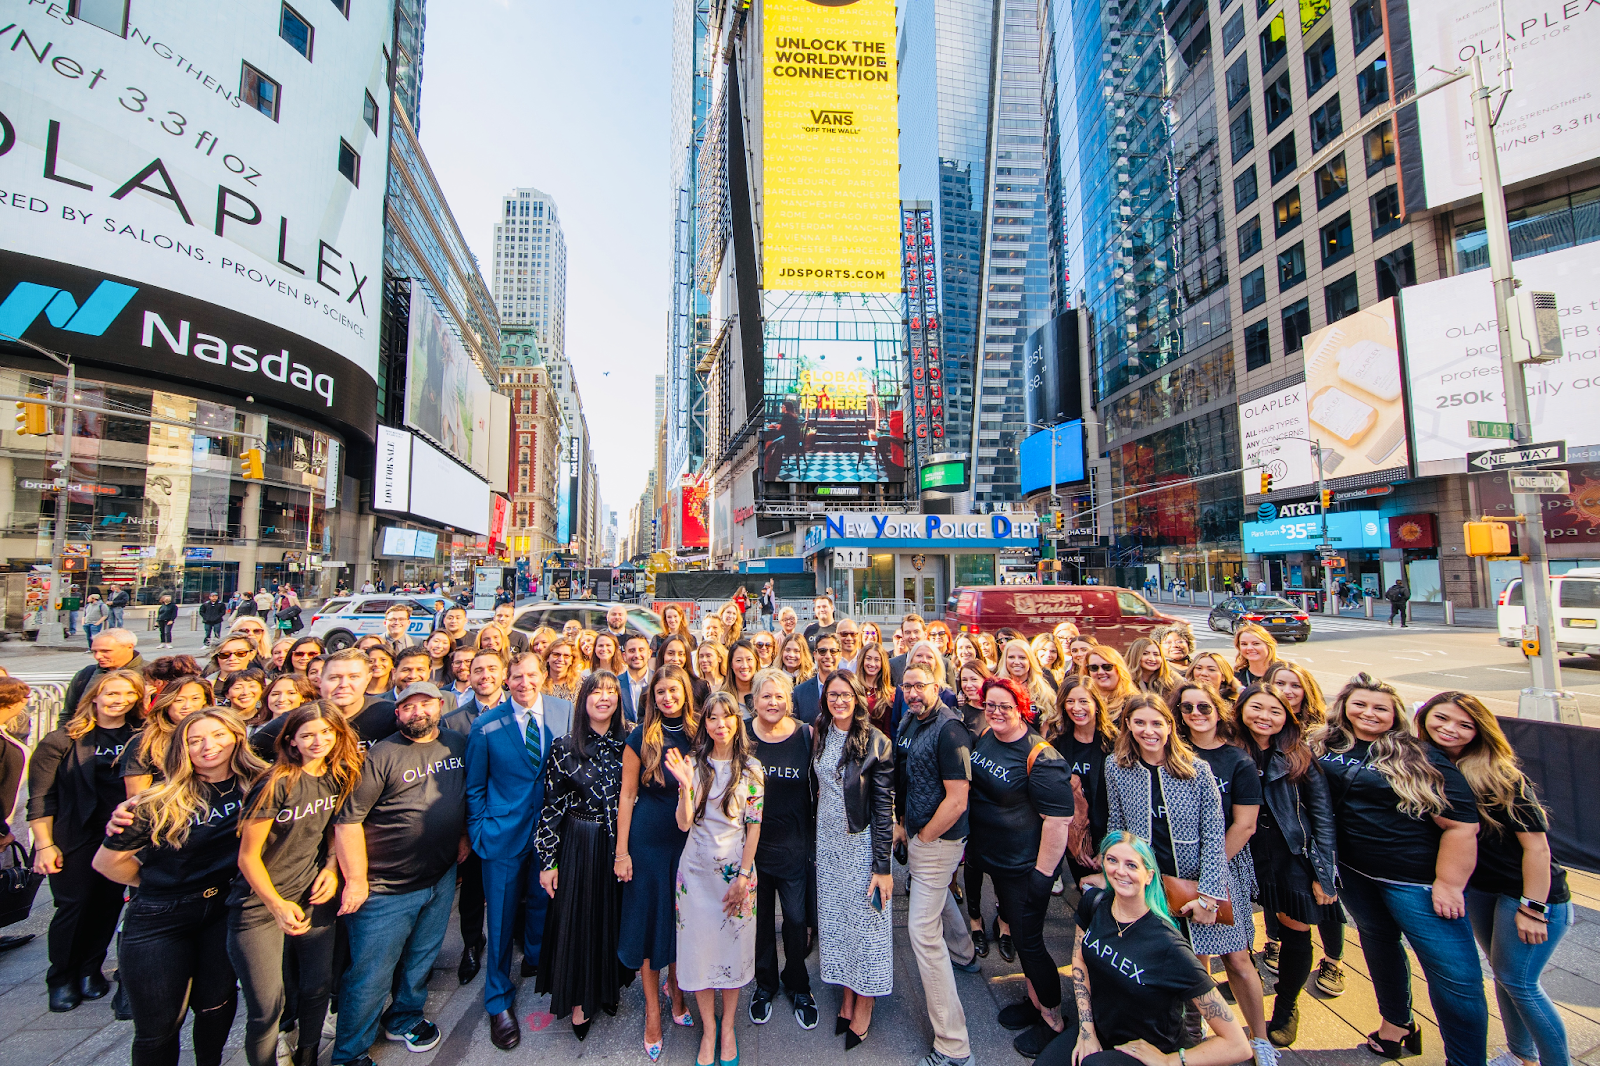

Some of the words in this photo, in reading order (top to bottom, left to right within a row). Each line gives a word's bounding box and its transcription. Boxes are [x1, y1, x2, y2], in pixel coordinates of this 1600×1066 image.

[766, 4, 829, 14] MANCHESTER
[839, 7, 896, 17] BARCELONA
[823, 17, 849, 25] ROME
[860, 19, 887, 28] PARIS
[778, 25, 804, 33] ROME
[815, 28, 872, 36] STOCKHOLM
[775, 37, 847, 52] UNLOCK
[852, 41, 886, 54] THE
[127, 20, 243, 109] NGTHENS
[775, 51, 887, 67] WORLDWIDE
[773, 65, 888, 82] CONNECTION
[803, 80, 861, 89] AMSTERDAM
[808, 90, 865, 99] BARCELONA
[779, 100, 819, 109] LONDON
[829, 102, 851, 110] NEW
[854, 104, 880, 112] YORK
[810, 109, 854, 126] VANS
[118, 86, 187, 136] 3.3
[222, 153, 262, 188] oz
[780, 133, 819, 141] LUMPUR
[829, 135, 865, 143] VIENNA
[781, 144, 819, 152] MUNICH
[829, 145, 872, 154] HELSINKI
[788, 155, 813, 163] YORK
[825, 156, 858, 165] BERLIN
[807, 167, 850, 176] CHICAGO
[861, 168, 891, 177] SEOUL
[778, 177, 837, 187] MELBOURNE
[847, 179, 875, 188] PARIS
[765, 187, 824, 197] BARCELONA
[781, 199, 845, 208] MANCHESTER
[856, 202, 877, 210] NEW
[780, 210, 807, 219] ROME
[818, 212, 862, 220] CHICAGO
[774, 222, 834, 230] AMSTERDAM
[784, 233, 821, 241] VIENNA
[831, 235, 878, 243] BANGKOK
[766, 245, 831, 253] MANCHESTER
[780, 256, 815, 264] BERLIN
[826, 257, 853, 266] ROME
[863, 258, 891, 267] PARIS
[905, 217, 918, 299] ERNST
[62, 205, 94, 225] BY
[103, 217, 212, 265] SALONS.
[221, 257, 298, 299] PROVEN
[304, 294, 319, 309] BY
[323, 308, 366, 341] SCIENCE.
[779, 268, 885, 280] JDSPORTS.COM
[775, 279, 803, 287] PARIS
[814, 280, 869, 288] SINGAPORE
[141, 310, 335, 407] Nasdaq
[1354, 347, 1381, 378] OLAPLEX
[800, 370, 868, 383] GLOBAL
[801, 383, 868, 396] ACCESS
[913, 347, 928, 438] YOUNG
[801, 396, 817, 410] IS
[821, 397, 867, 410] HERE
[1244, 391, 1300, 419] OLAPLEX
[1436, 390, 1494, 410] 250k
[1245, 430, 1258, 439] ALL
[1258, 425, 1275, 435] HAIR
[1480, 424, 1489, 436] W
[1492, 424, 1503, 437] 43
[1246, 440, 1260, 450] ANY
[1480, 454, 1506, 466] ONE
[1520, 448, 1551, 461] WAY
[1519, 477, 1537, 487] ONE
[1543, 478, 1560, 487] WAY
[1279, 502, 1316, 517] AT&T
[826, 515, 868, 539] NEW
[871, 515, 922, 539] YORK
[926, 515, 987, 539] POLICE
[992, 515, 1040, 539] DEPT
[1251, 530, 1264, 538] Plans
[1265, 529, 1279, 537] from
[1280, 522, 1308, 540] $35
[1083, 928, 1146, 986] LAPLEX.
